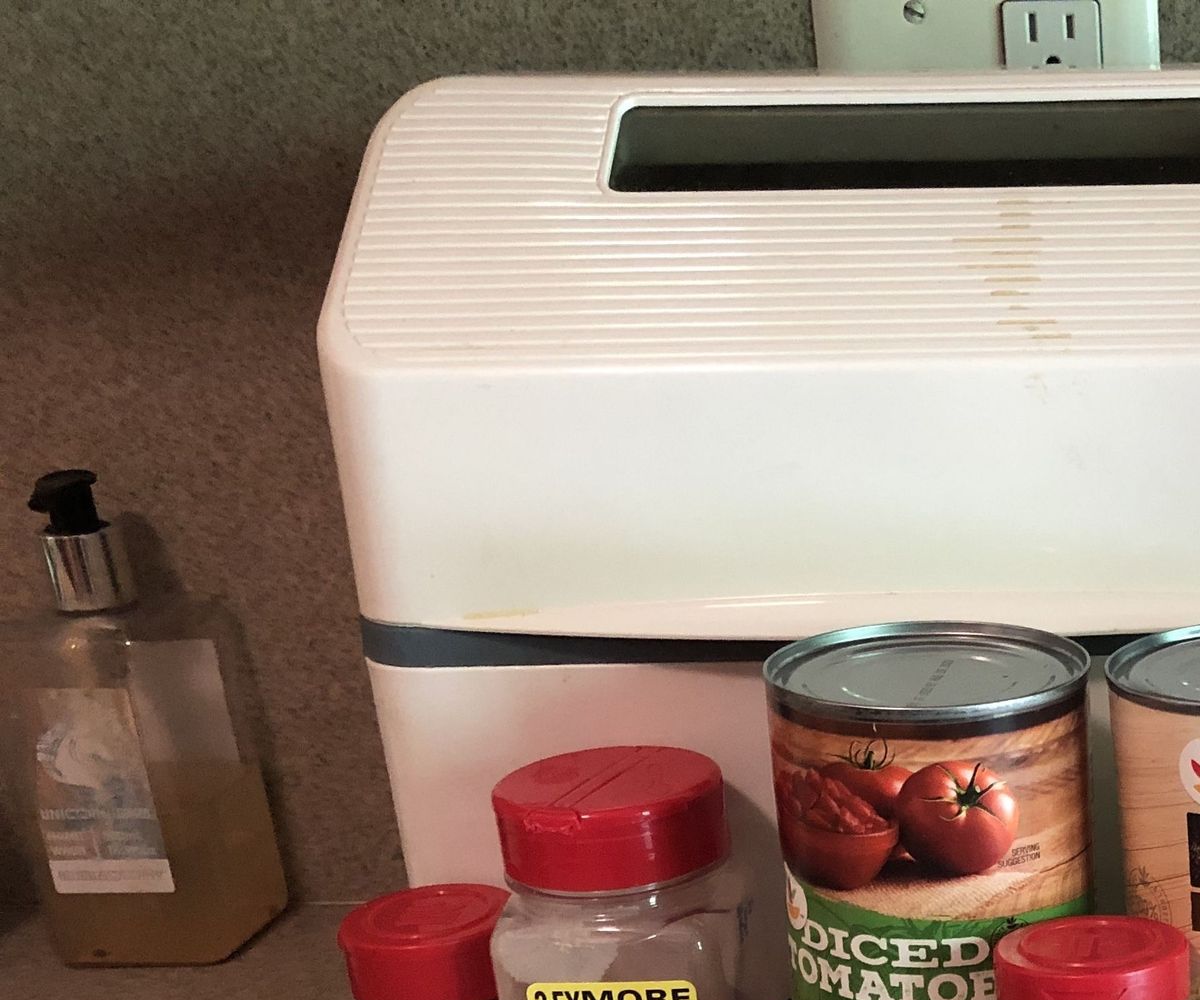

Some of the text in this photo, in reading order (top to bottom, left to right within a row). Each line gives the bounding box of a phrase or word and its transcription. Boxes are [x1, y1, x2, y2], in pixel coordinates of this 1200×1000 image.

[1012, 843, 1040, 857] SERVING
[998, 851, 1041, 869] SUGGESTION
[801, 919, 990, 968] DICED
